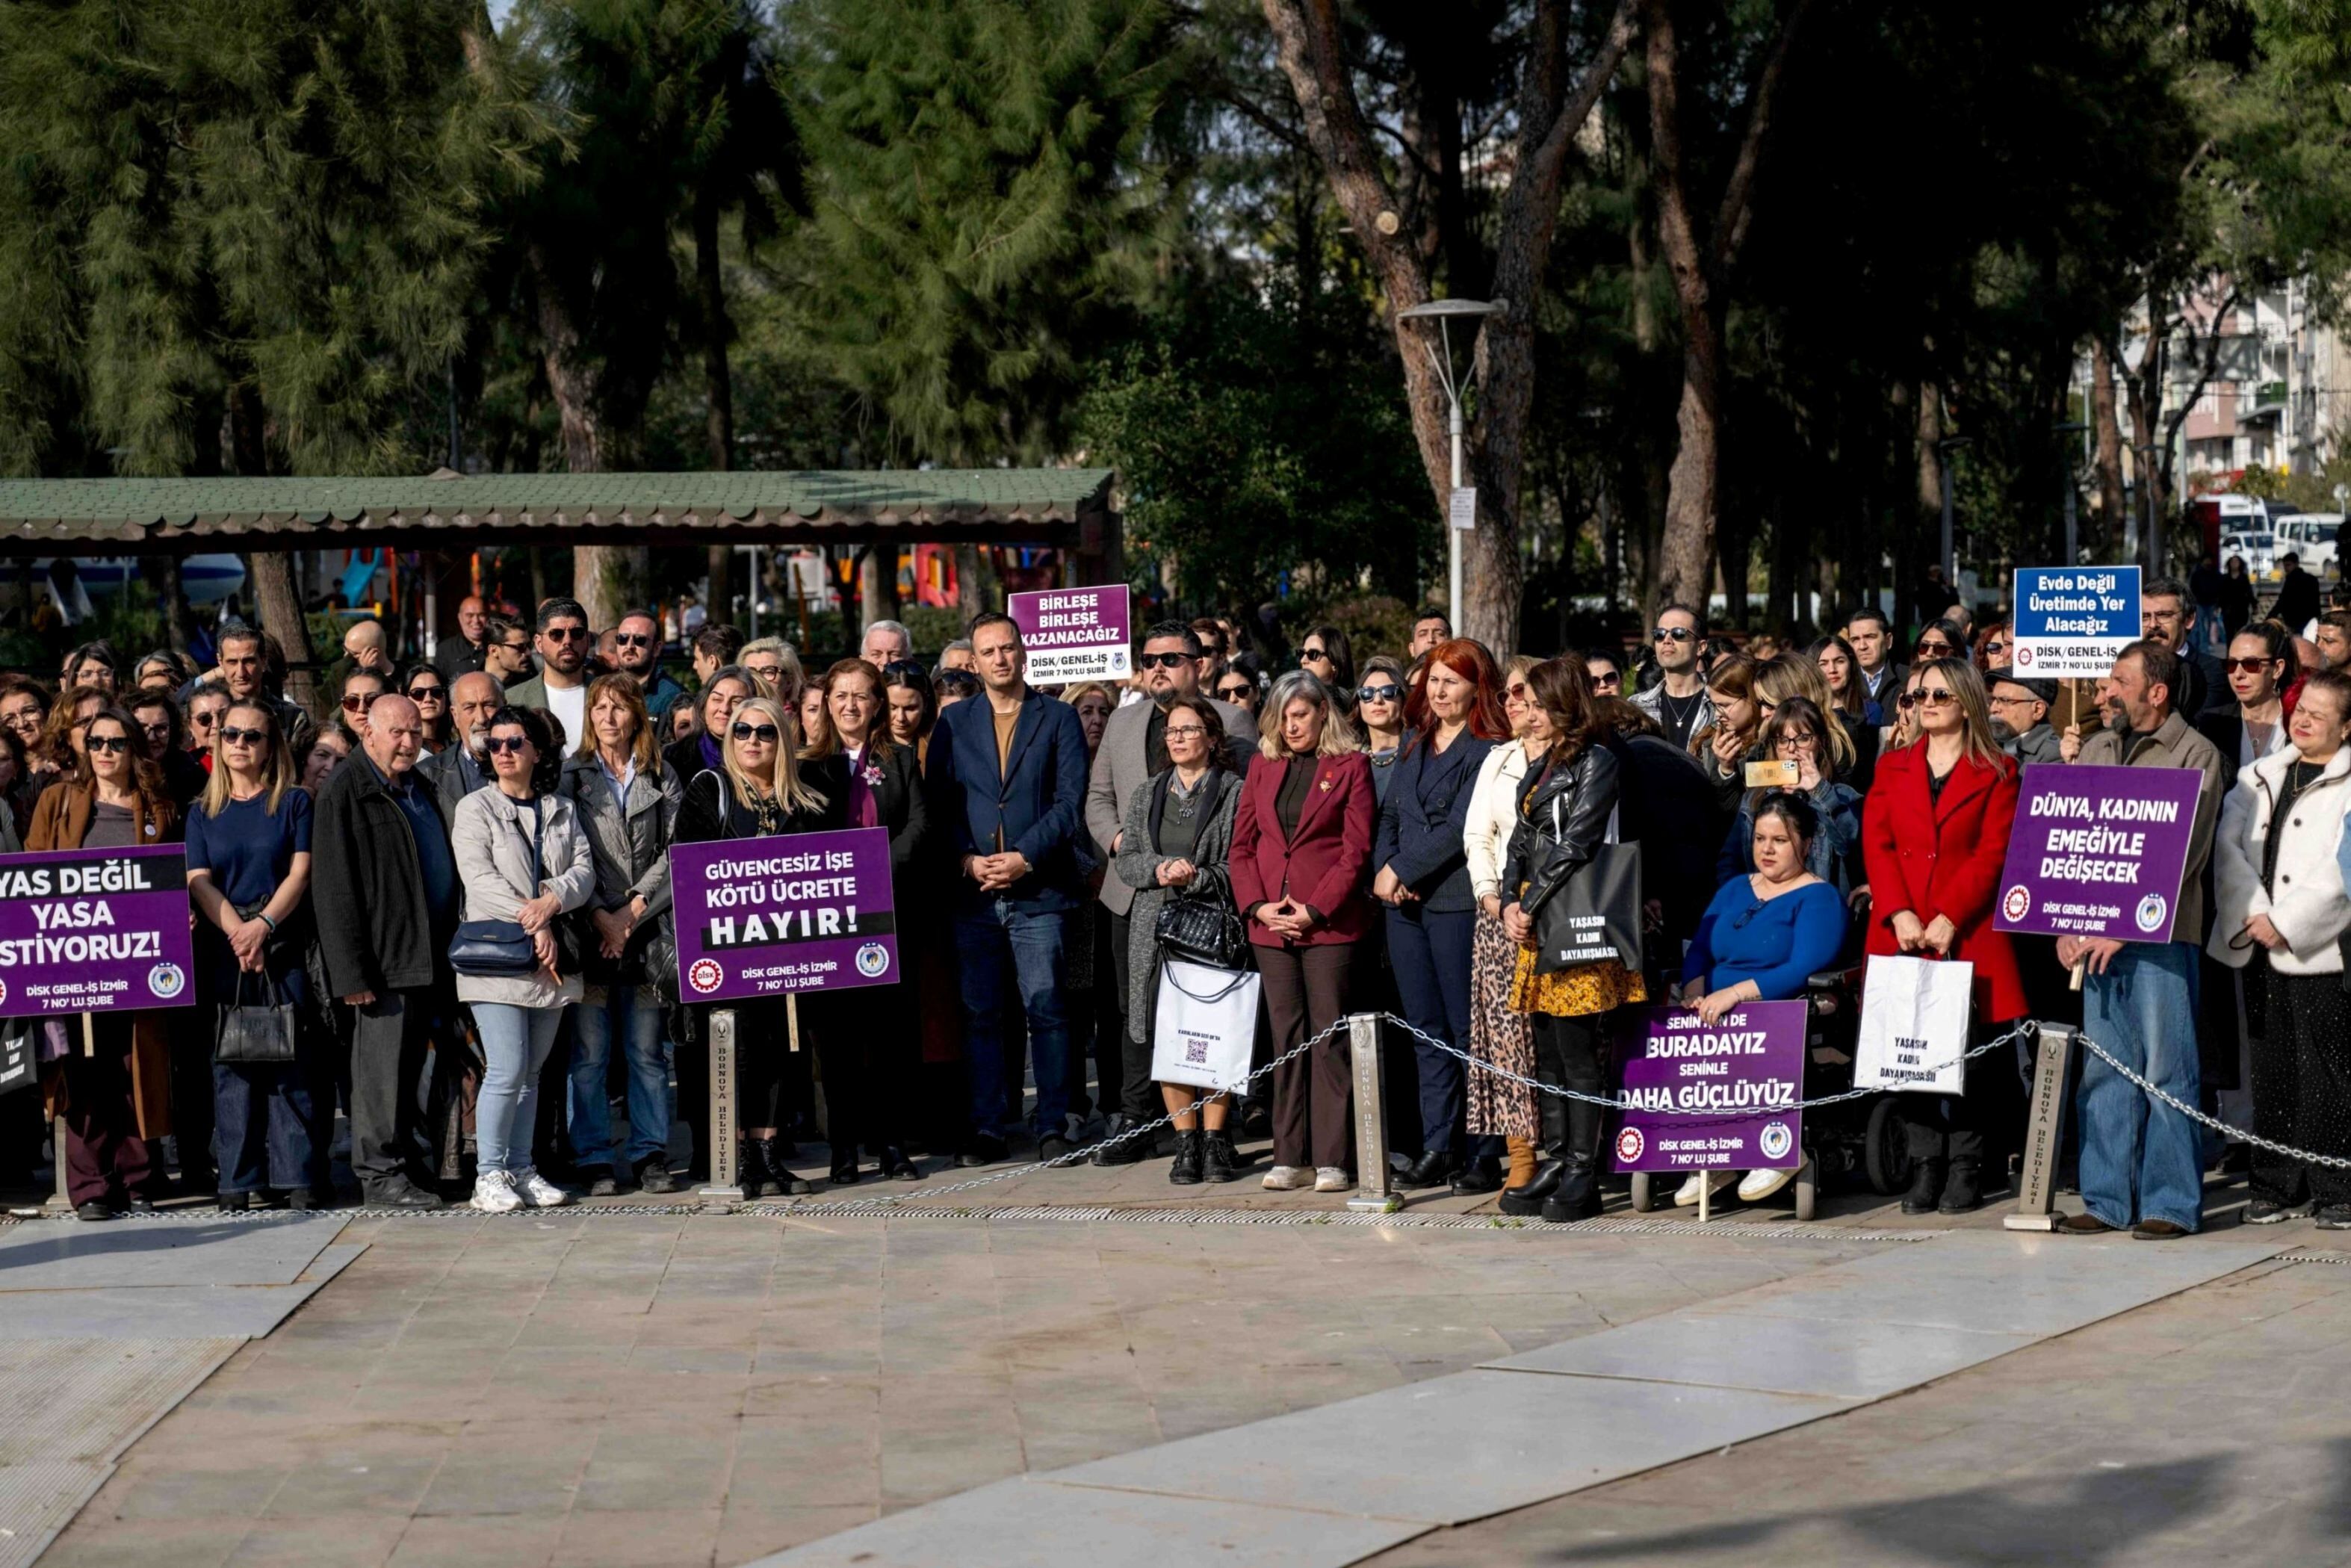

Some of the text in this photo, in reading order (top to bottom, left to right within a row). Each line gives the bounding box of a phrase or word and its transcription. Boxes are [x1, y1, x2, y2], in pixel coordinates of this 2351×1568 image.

[2039, 574, 2116, 594] Evde Değil
[1039, 595, 1098, 610] BİRLEŞE
[2029, 592, 2125, 611] Üretimde Yer
[1039, 611, 1098, 628] BİRLEŞE
[2045, 615, 2108, 635] Alacağız
[1020, 625, 1120, 646] KAZANACAĞIZ
[1032, 651, 1108, 668] DİSK/GENEL-İŞ
[2036, 643, 2117, 660] DİSK/GENEL-İŞ
[1033, 669, 1055, 678] İZMİR
[1062, 667, 1085, 675] NO'LU
[1087, 666, 1106, 676] ŞUBE
[2038, 660, 2060, 669] İZMİR
[2063, 661, 2067, 669] 7
[2069, 661, 2093, 669] NO'LU
[2030, 792, 2178, 822] DÜNYA, KADININ
[2046, 825, 2146, 855] EMEĞİYLE
[705, 850, 854, 880] GÜVENCESİZ İŞE
[2039, 855, 2141, 884] DEĞİŞECEK
[59, 858, 152, 894] DEĞİL
[706, 877, 856, 908] KÖTÜ ÜCRETE
[31, 900, 115, 929] YASA
[2042, 901, 2120, 918] DİSK GENEL-İŞ İZMİR
[710, 905, 857, 945] HAYIR!
[1570, 916, 1606, 929] YAŞASIN
[2051, 917, 2057, 928] 7
[2084, 920, 2106, 932] ŞUBE
[1576, 932, 1600, 944] KADIN
[698, 970, 714, 979] DİSK
[742, 961, 837, 979] DİSK GENEL-İŞ İZMİR
[26, 979, 128, 997] DİSK GENEL-İŞ İZMİR
[757, 982, 763, 991] 7
[799, 976, 824, 988] ŞUBE
[43, 999, 49, 1009] 7
[87, 995, 114, 1008] ŞUBE
[1666, 1014, 1701, 1029] SENİN
[1730, 1014, 1747, 1027] DE
[1646, 1032, 1767, 1059] BURADAYIZ
[718, 1048, 726, 1099] BORNOVA
[1679, 1059, 1728, 1076] SENİNLE
[1617, 1078, 1794, 1110] DAHA GÜÇLÜYÜZ
[2039, 1069, 2054, 1122] BORNOVA
[1658, 1137, 1744, 1151] DİSK GENEL-İŞ İZMİR
[1670, 1155, 1676, 1164] 7
[1708, 1153, 1730, 1165] ŞUBE
